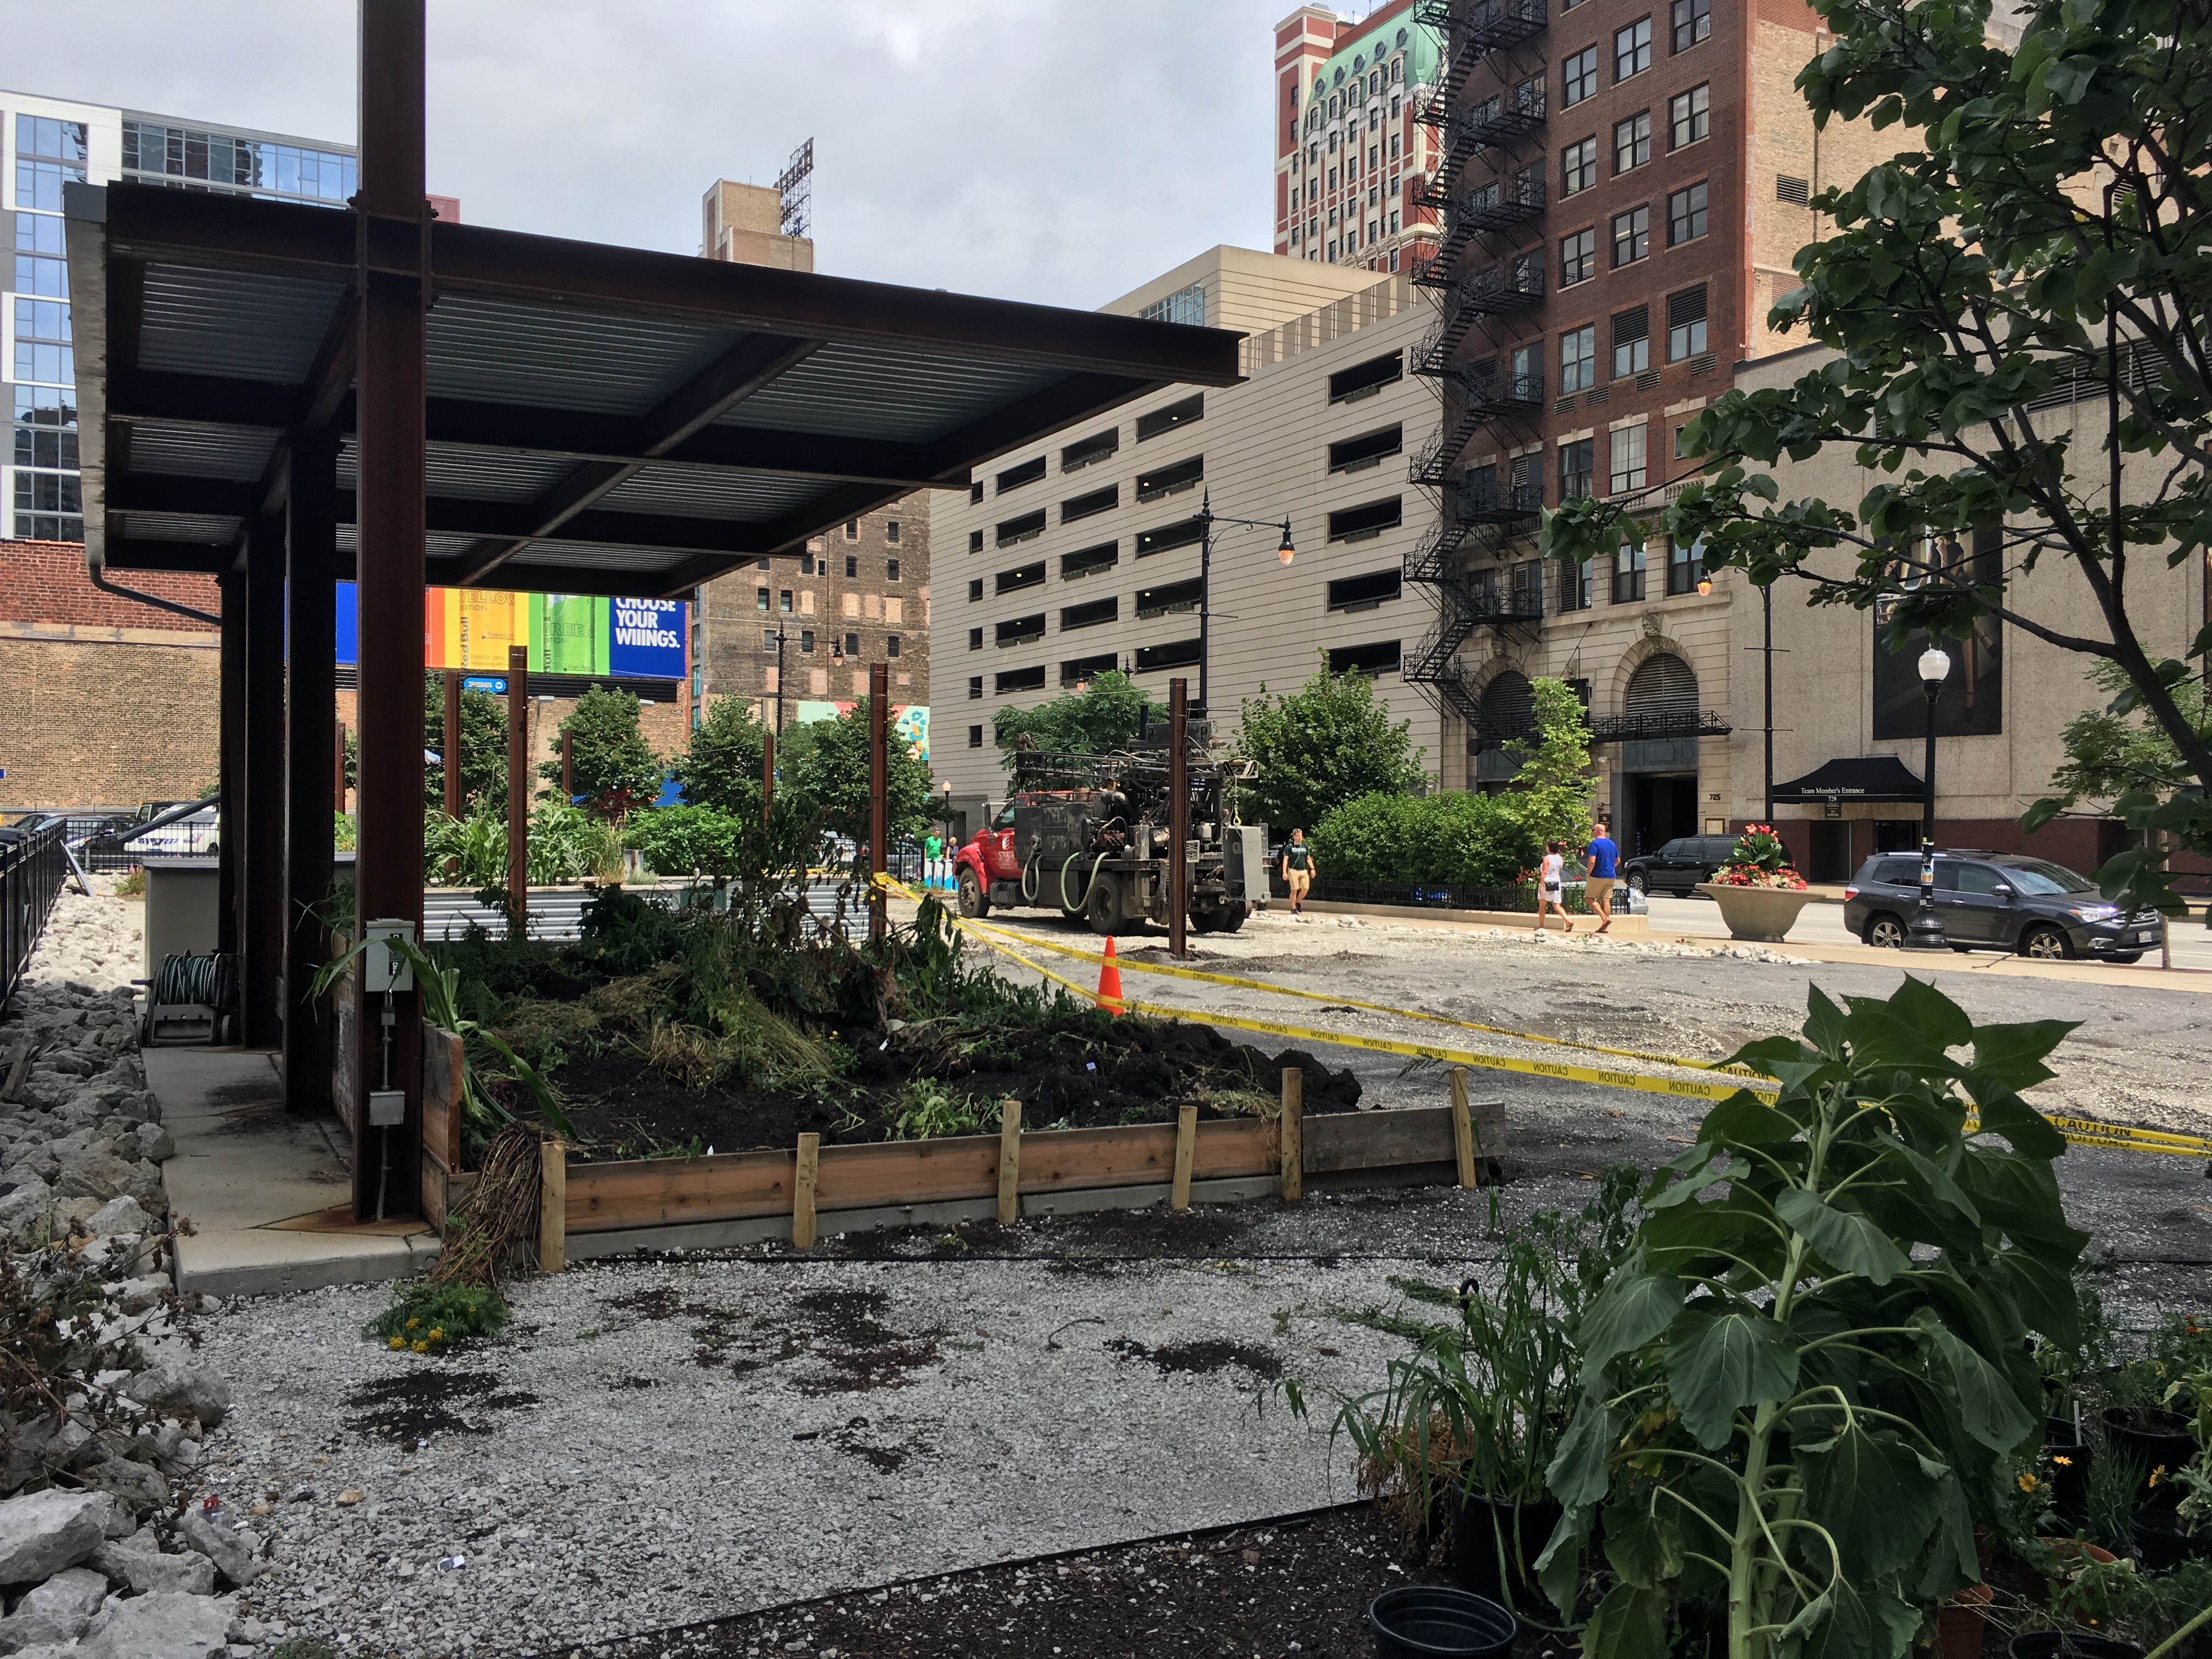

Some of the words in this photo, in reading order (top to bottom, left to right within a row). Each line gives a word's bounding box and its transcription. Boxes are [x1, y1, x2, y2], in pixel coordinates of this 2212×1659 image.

[460, 591, 515, 606] YELLOW
[616, 598, 676, 612] CHOOSE
[616, 610, 658, 628] YOUR
[543, 622, 593, 639] GREEN
[615, 628, 680, 648] WIIINGS.
